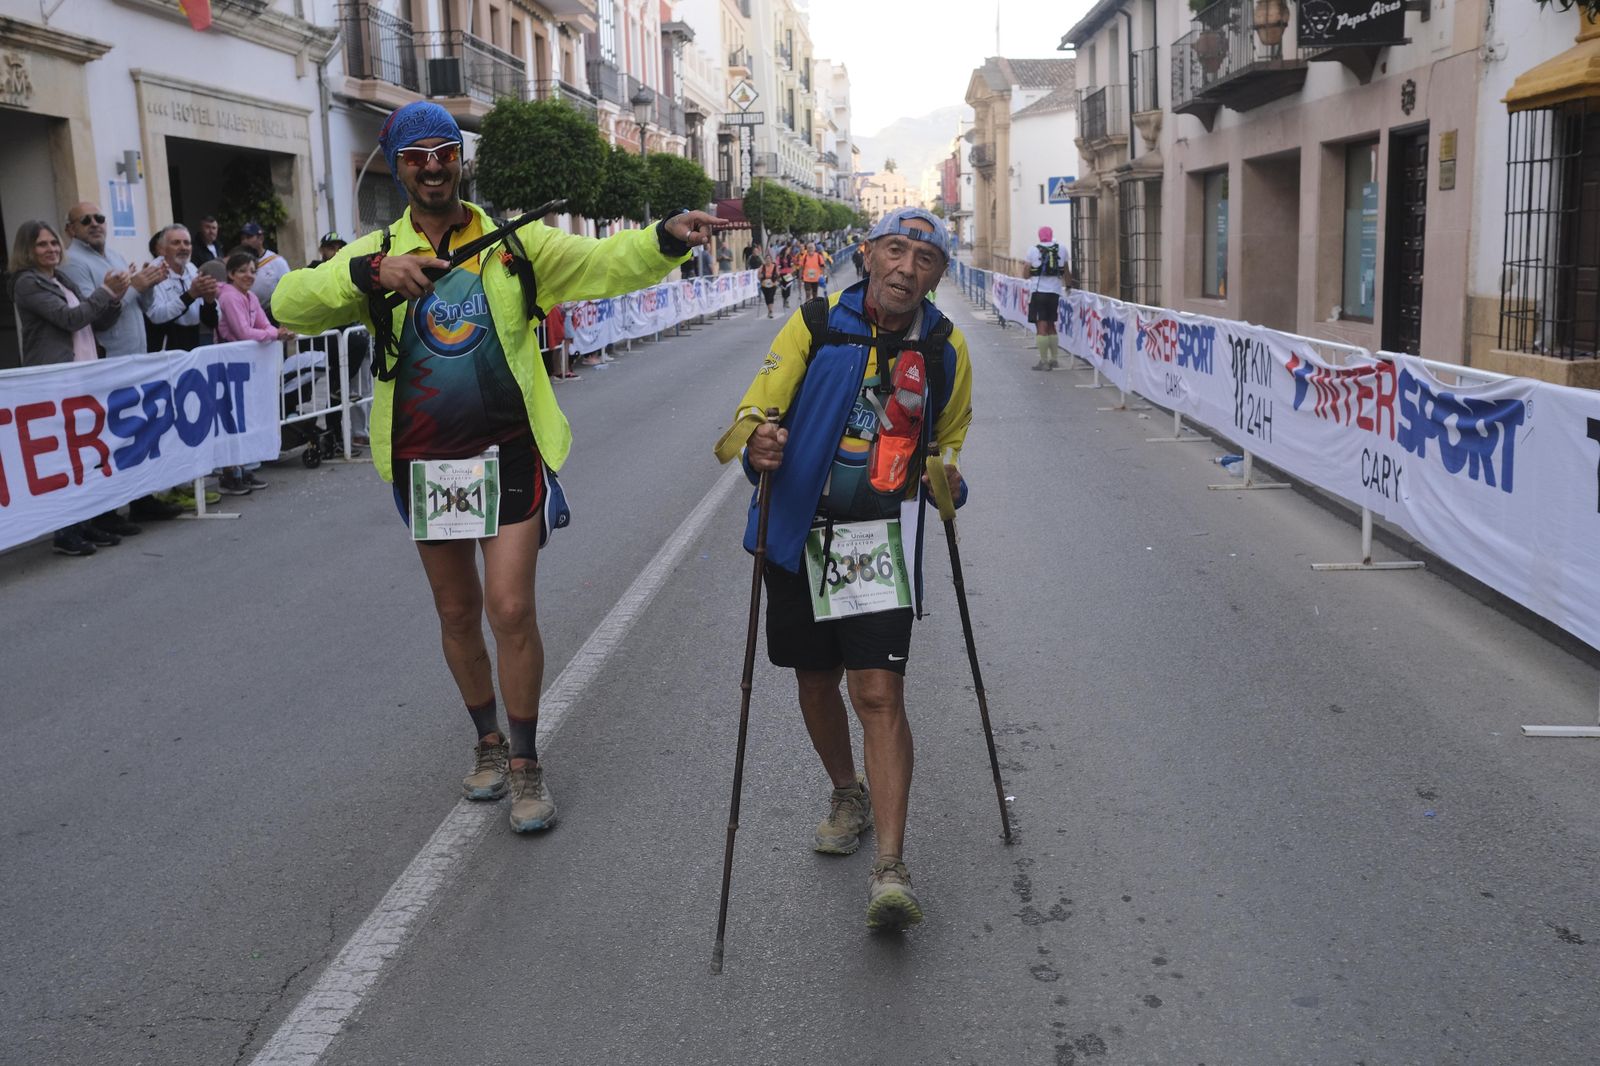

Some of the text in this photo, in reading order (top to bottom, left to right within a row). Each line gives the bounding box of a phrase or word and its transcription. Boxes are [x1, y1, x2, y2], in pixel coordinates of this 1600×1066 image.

[172, 101, 215, 127] HOTEL
[433, 293, 488, 323] Snell
[1251, 340, 1272, 389] KM
[848, 402, 879, 430] Sn
[1247, 393, 1273, 445] 24H
[1309, 359, 1525, 494] INTERSPORT
[1361, 447, 1402, 504] CARY
[428, 486, 483, 513] 1181
[826, 551, 894, 586] 3386
